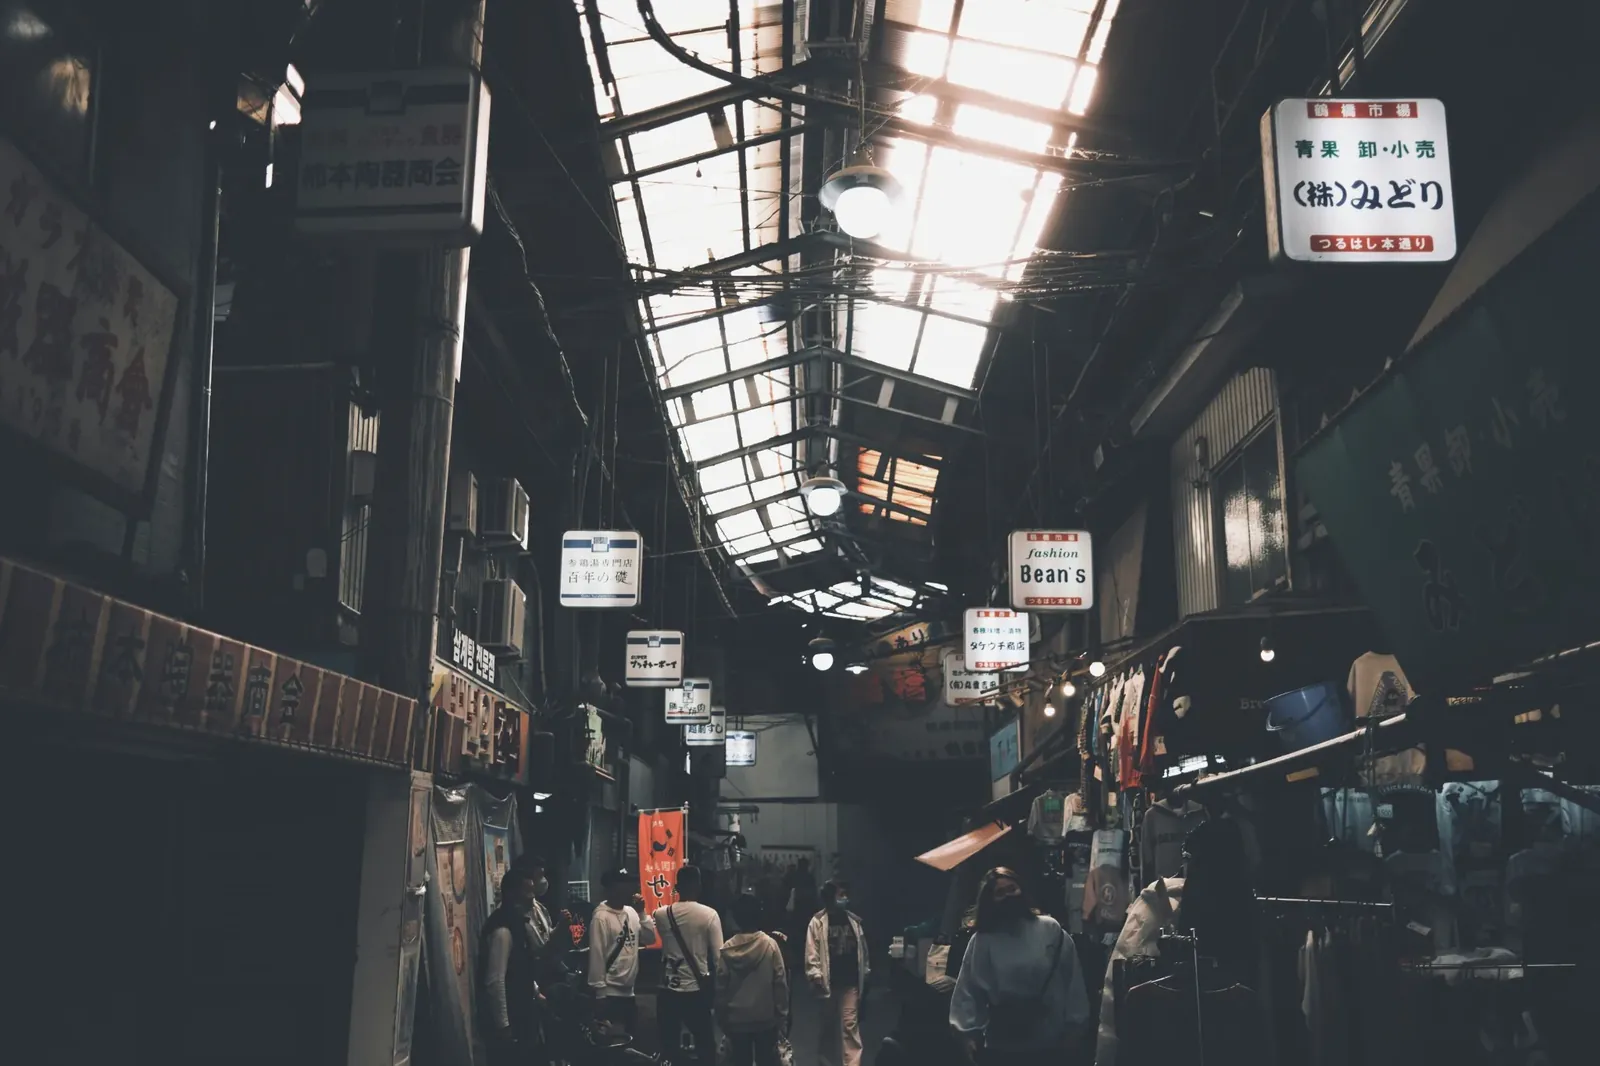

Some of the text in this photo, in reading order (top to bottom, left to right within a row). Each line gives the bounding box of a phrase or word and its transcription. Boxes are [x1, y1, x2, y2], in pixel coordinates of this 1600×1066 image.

[1314, 103, 1411, 118] 鶴橋市場
[1294, 178, 1444, 210] (株)みどり
[1319, 237, 1426, 250] つるはし本通り
[1026, 548, 1079, 560] fashion
[1020, 565, 1086, 584] Bean's
[453, 628, 496, 684] 삼계탕 전문점
